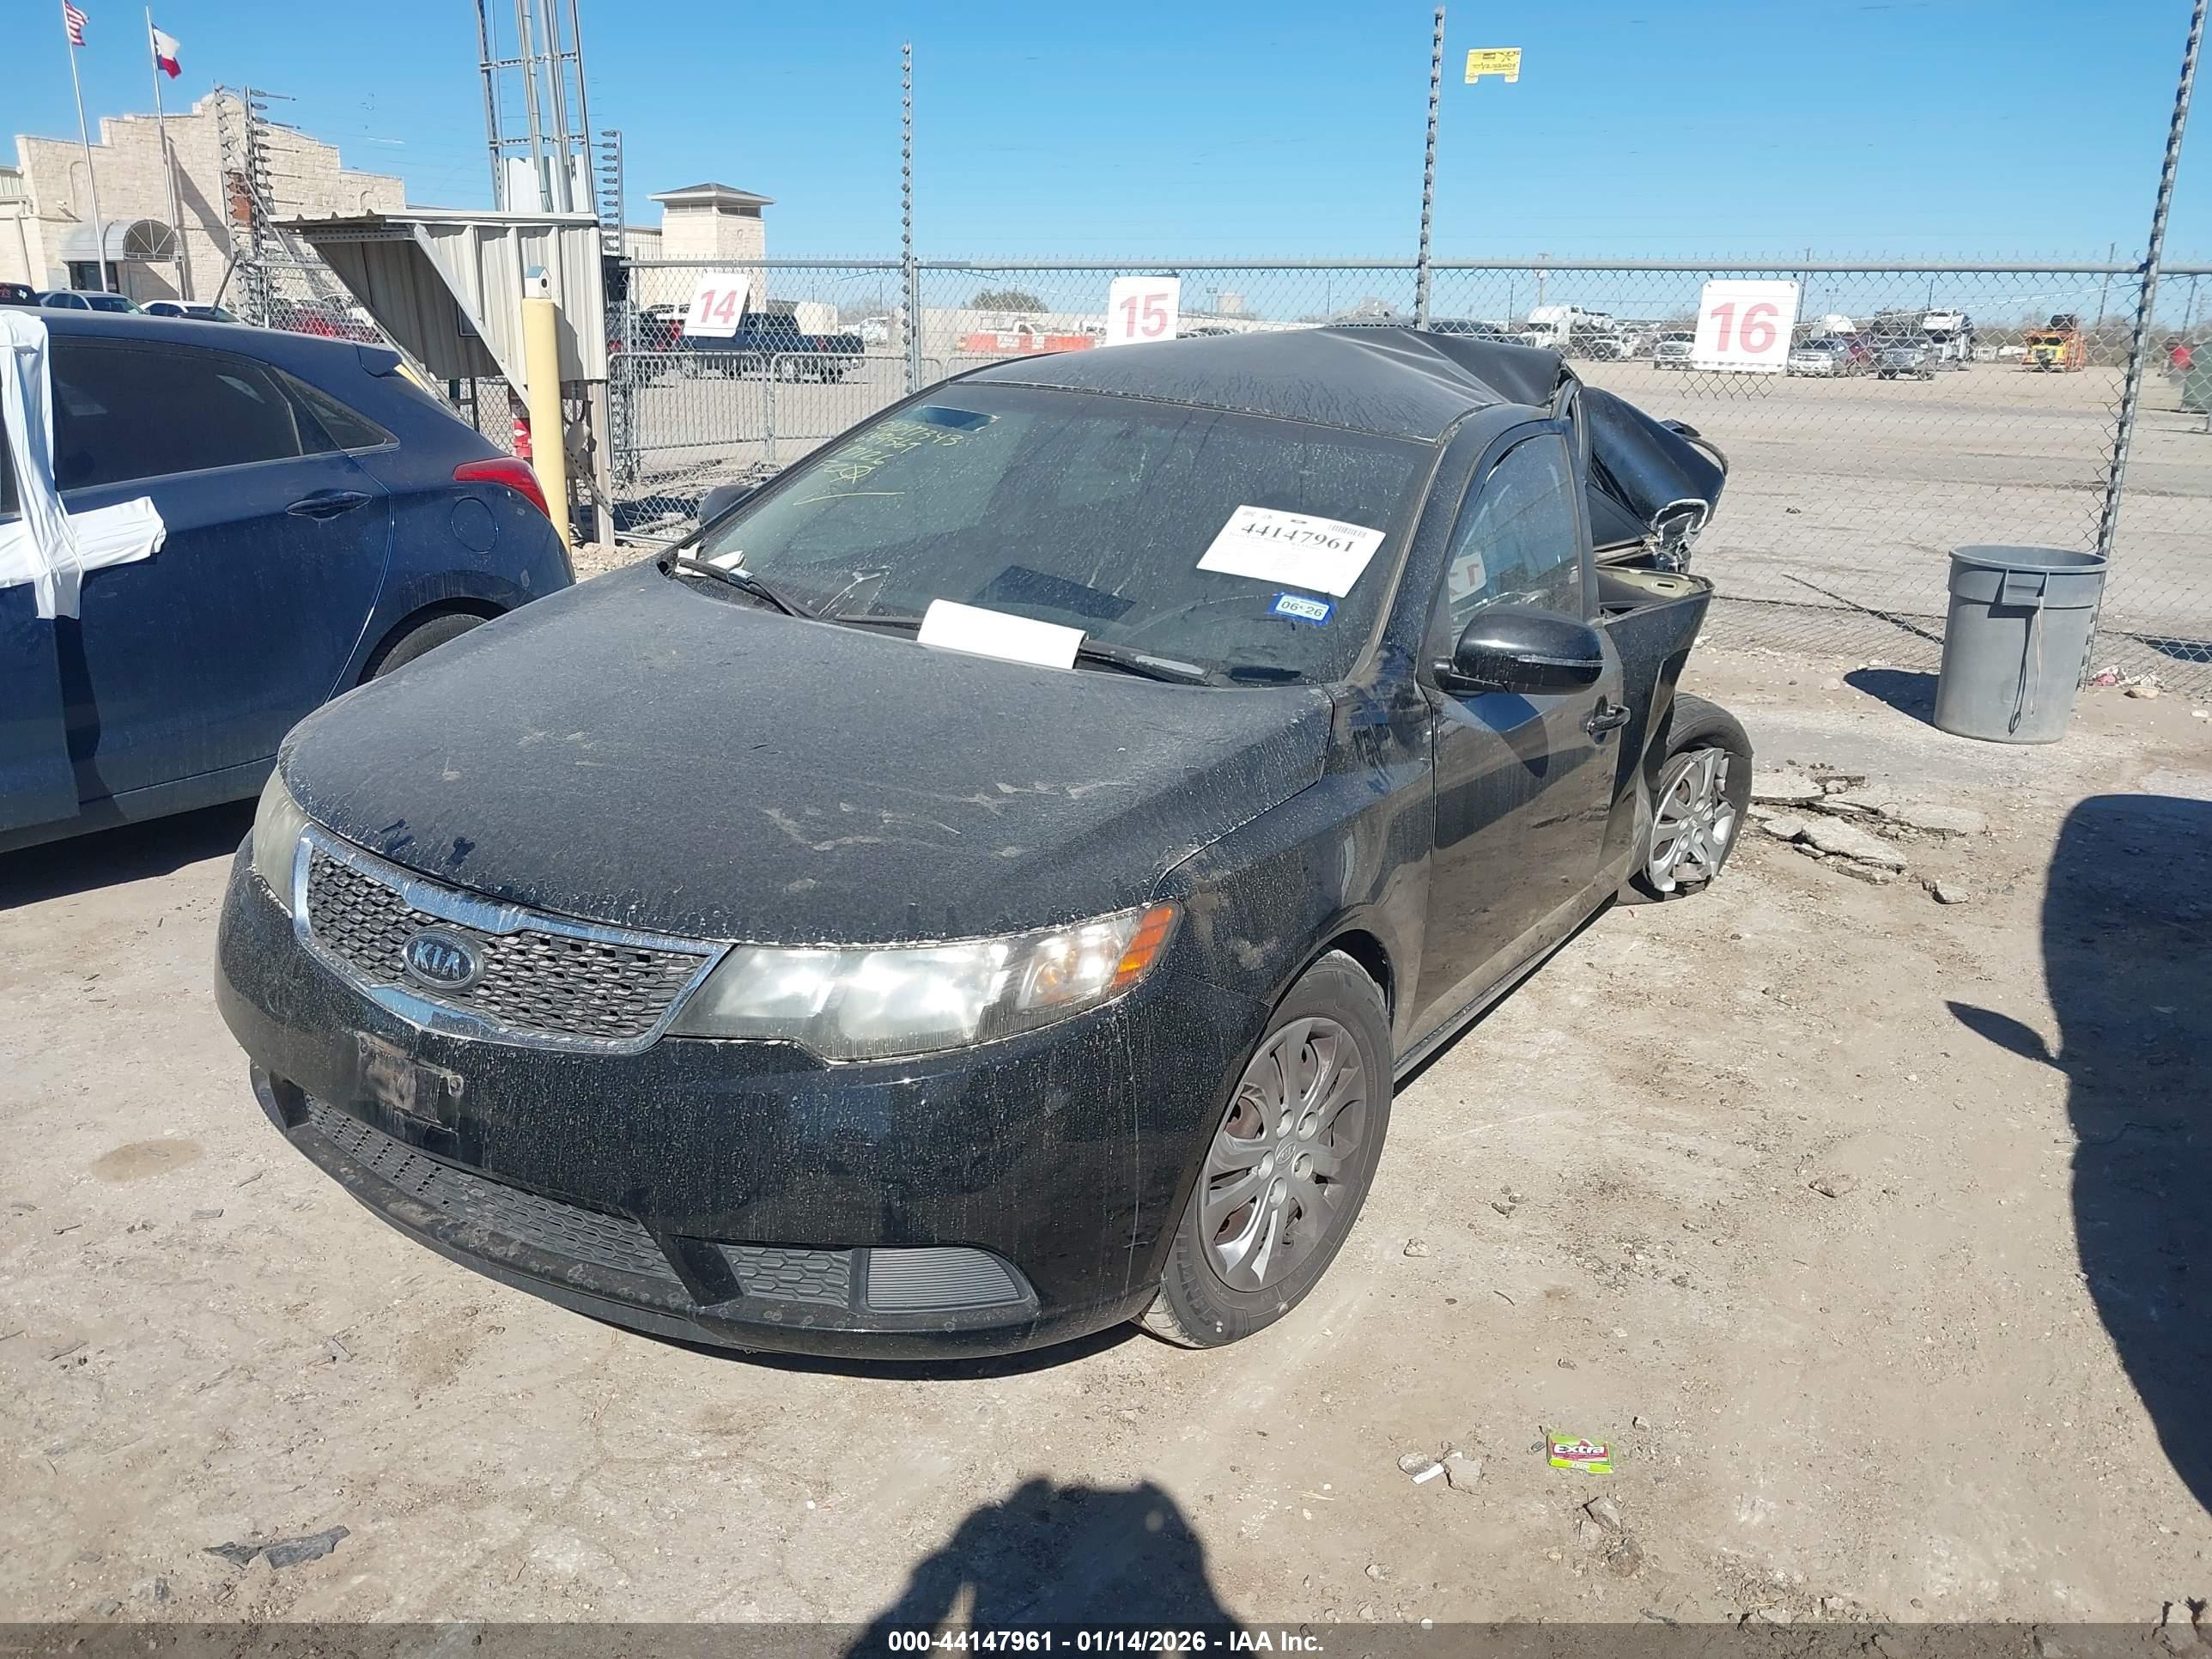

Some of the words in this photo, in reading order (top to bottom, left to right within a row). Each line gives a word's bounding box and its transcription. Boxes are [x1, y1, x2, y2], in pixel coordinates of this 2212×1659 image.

[701, 289, 738, 324] 14
[1120, 293, 1168, 337] 15
[1711, 301, 1779, 354] 16
[1241, 522, 1355, 553] 44147961
[1281, 601, 1299, 611] 06
[1305, 606, 1323, 617] 26
[413, 940, 460, 980] KIA
[1553, 1443, 1605, 1453] Extra
